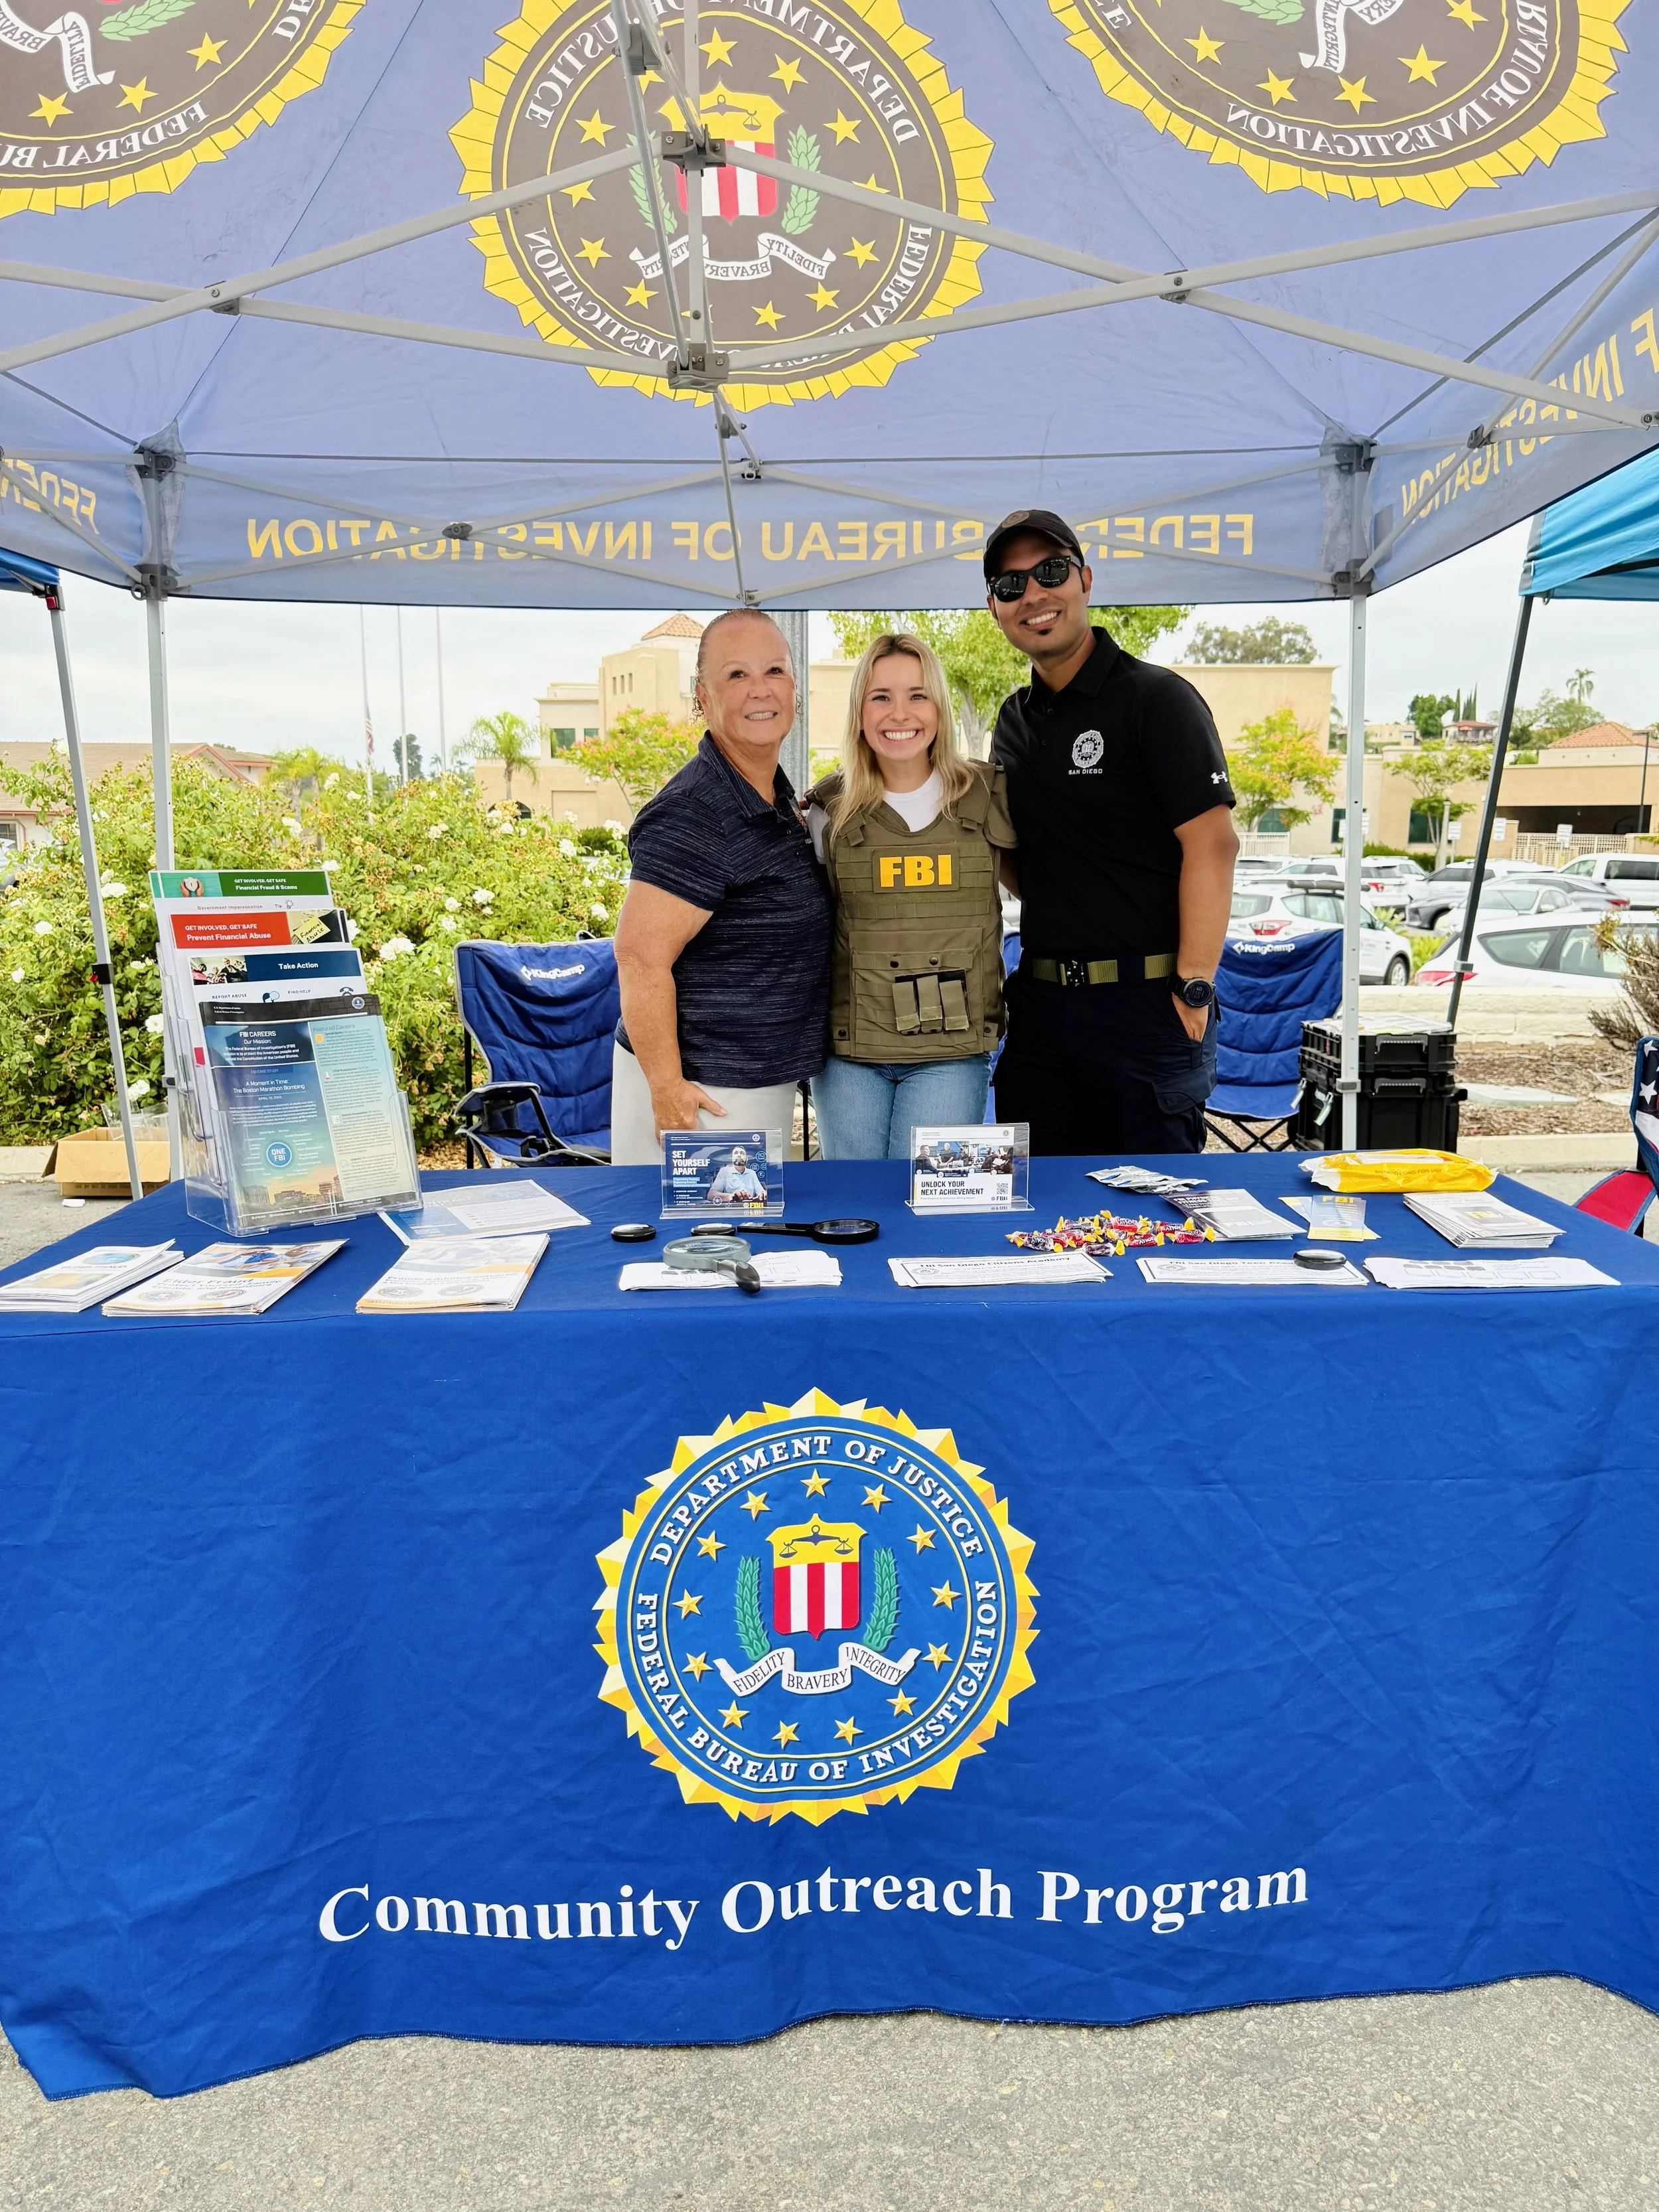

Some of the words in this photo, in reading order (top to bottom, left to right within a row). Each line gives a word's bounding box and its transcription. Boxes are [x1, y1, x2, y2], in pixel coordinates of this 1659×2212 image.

[879, 854, 952, 887] FBI
[1244, 943, 1295, 955] KingCamp
[530, 964, 585, 979] KingCamp
[672, 1150, 686, 1159] SET
[650, 1436, 831, 1566] DEPARTMENT
[843, 1440, 887, 1465] OF
[887, 1454, 984, 1559] JUSTICE
[733, 1651, 786, 1693] FIDELITY
[786, 1668, 849, 1690] BRAVERY
[845, 1645, 906, 1682] INTEGRITY
[637, 1592, 687, 1730] FEDERAL
[686, 1727, 798, 1783] BUREAU
[808, 1759, 849, 1781] OF
[861, 1580, 997, 1775] INVESTIGATION
[319, 1883, 701, 1951] Community
[721, 1866, 1014, 1933] Outreach
[1036, 1868, 1309, 1934] Program
